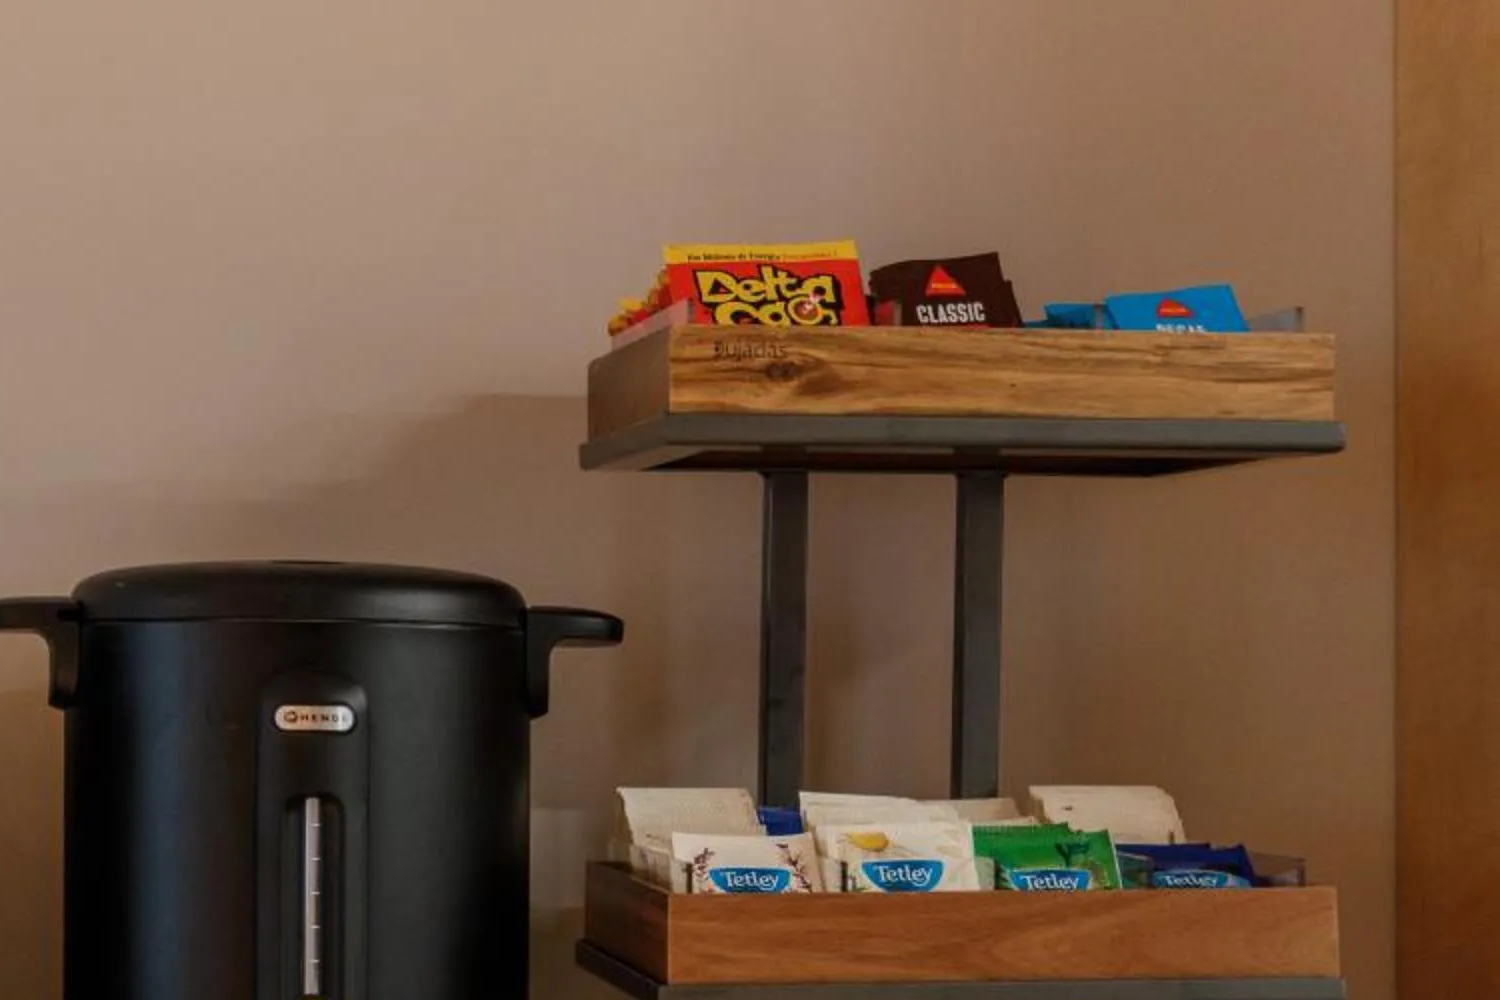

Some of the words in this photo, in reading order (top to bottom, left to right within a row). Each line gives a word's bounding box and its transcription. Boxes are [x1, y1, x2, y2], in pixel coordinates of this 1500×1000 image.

[693, 264, 838, 304] Delta
[916, 302, 986, 323] CLASSIC
[723, 871, 779, 891] Tetley
[873, 863, 933, 887] Tetley
[1020, 873, 1079, 890] Tetley
[1164, 873, 1218, 888] Tetley
